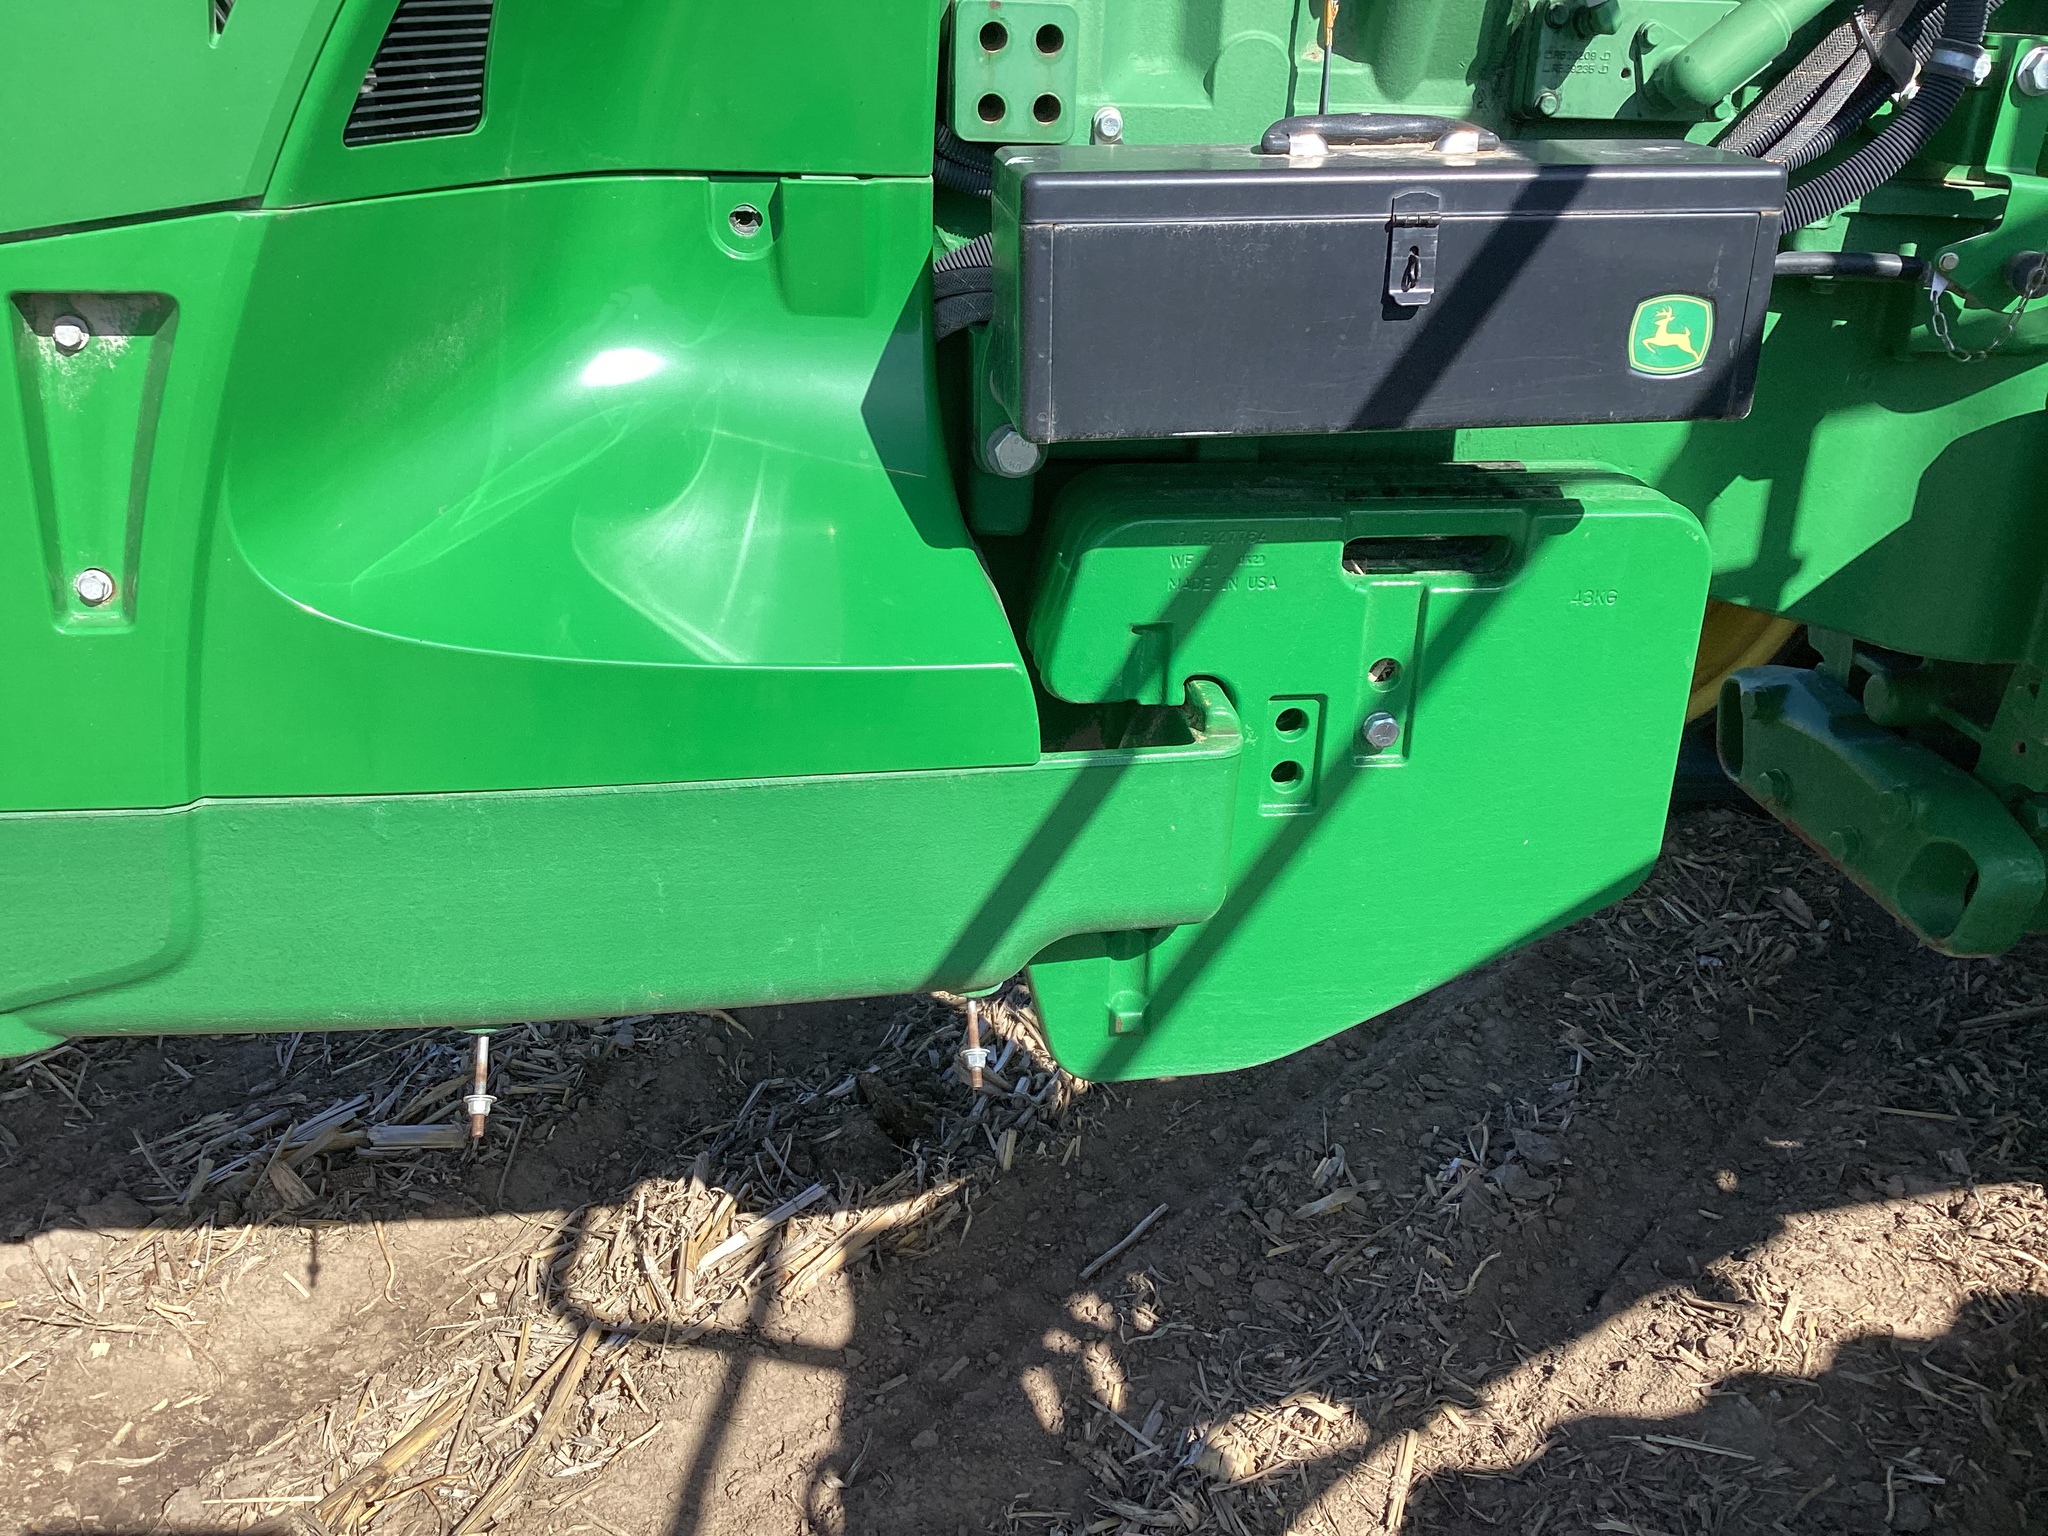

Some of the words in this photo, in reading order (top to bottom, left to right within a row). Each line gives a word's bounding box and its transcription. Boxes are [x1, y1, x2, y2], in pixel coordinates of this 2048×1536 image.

[1168, 553, 1195, 569] WF
[1166, 576, 1212, 592] MADE
[1221, 576, 1239, 592] IN
[1247, 575, 1279, 592] USA
